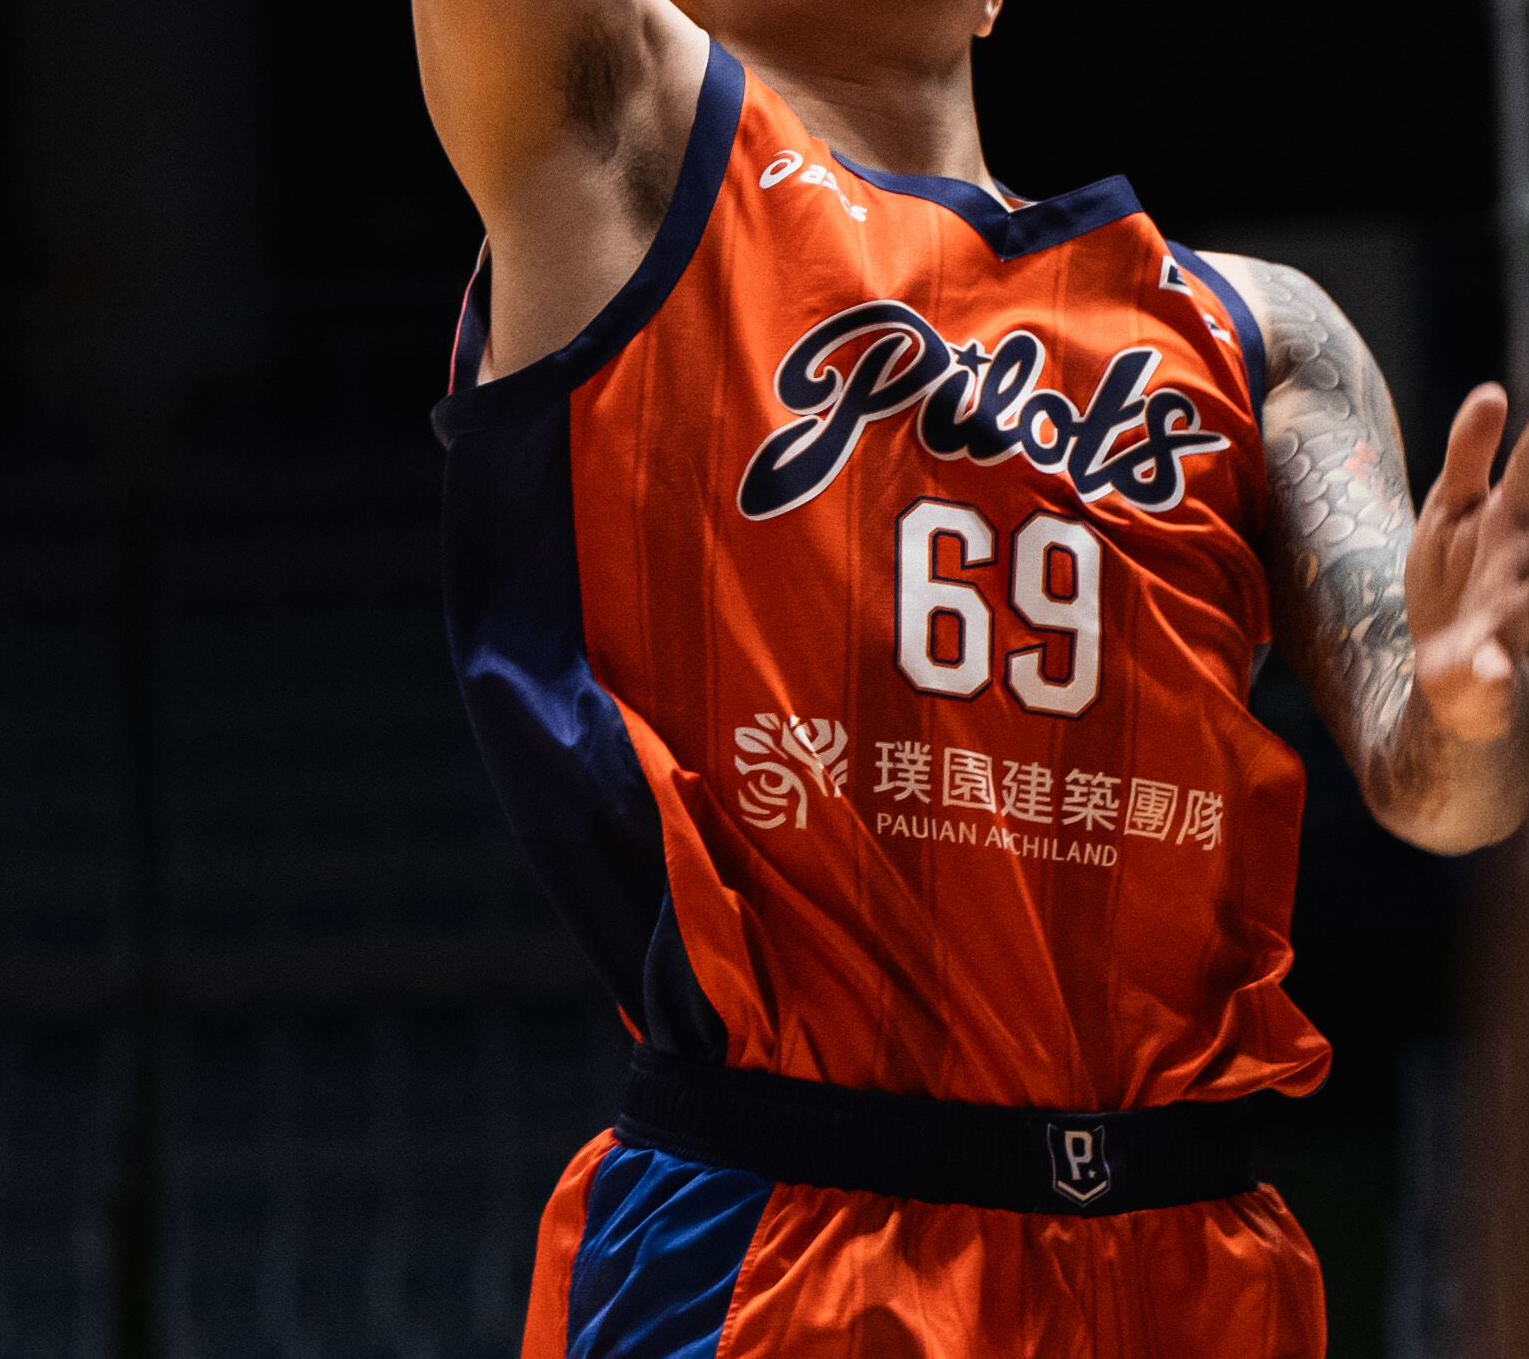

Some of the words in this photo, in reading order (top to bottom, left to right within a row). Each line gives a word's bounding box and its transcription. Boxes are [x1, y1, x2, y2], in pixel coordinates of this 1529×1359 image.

[799, 164, 868, 222] ascs
[735, 298, 1231, 522] Pilots
[893, 495, 1104, 719] 69
[873, 740, 1224, 851] 璞園建築團隊
[876, 811, 977, 846] PAUIAN
[1063, 1130, 1094, 1181] P
